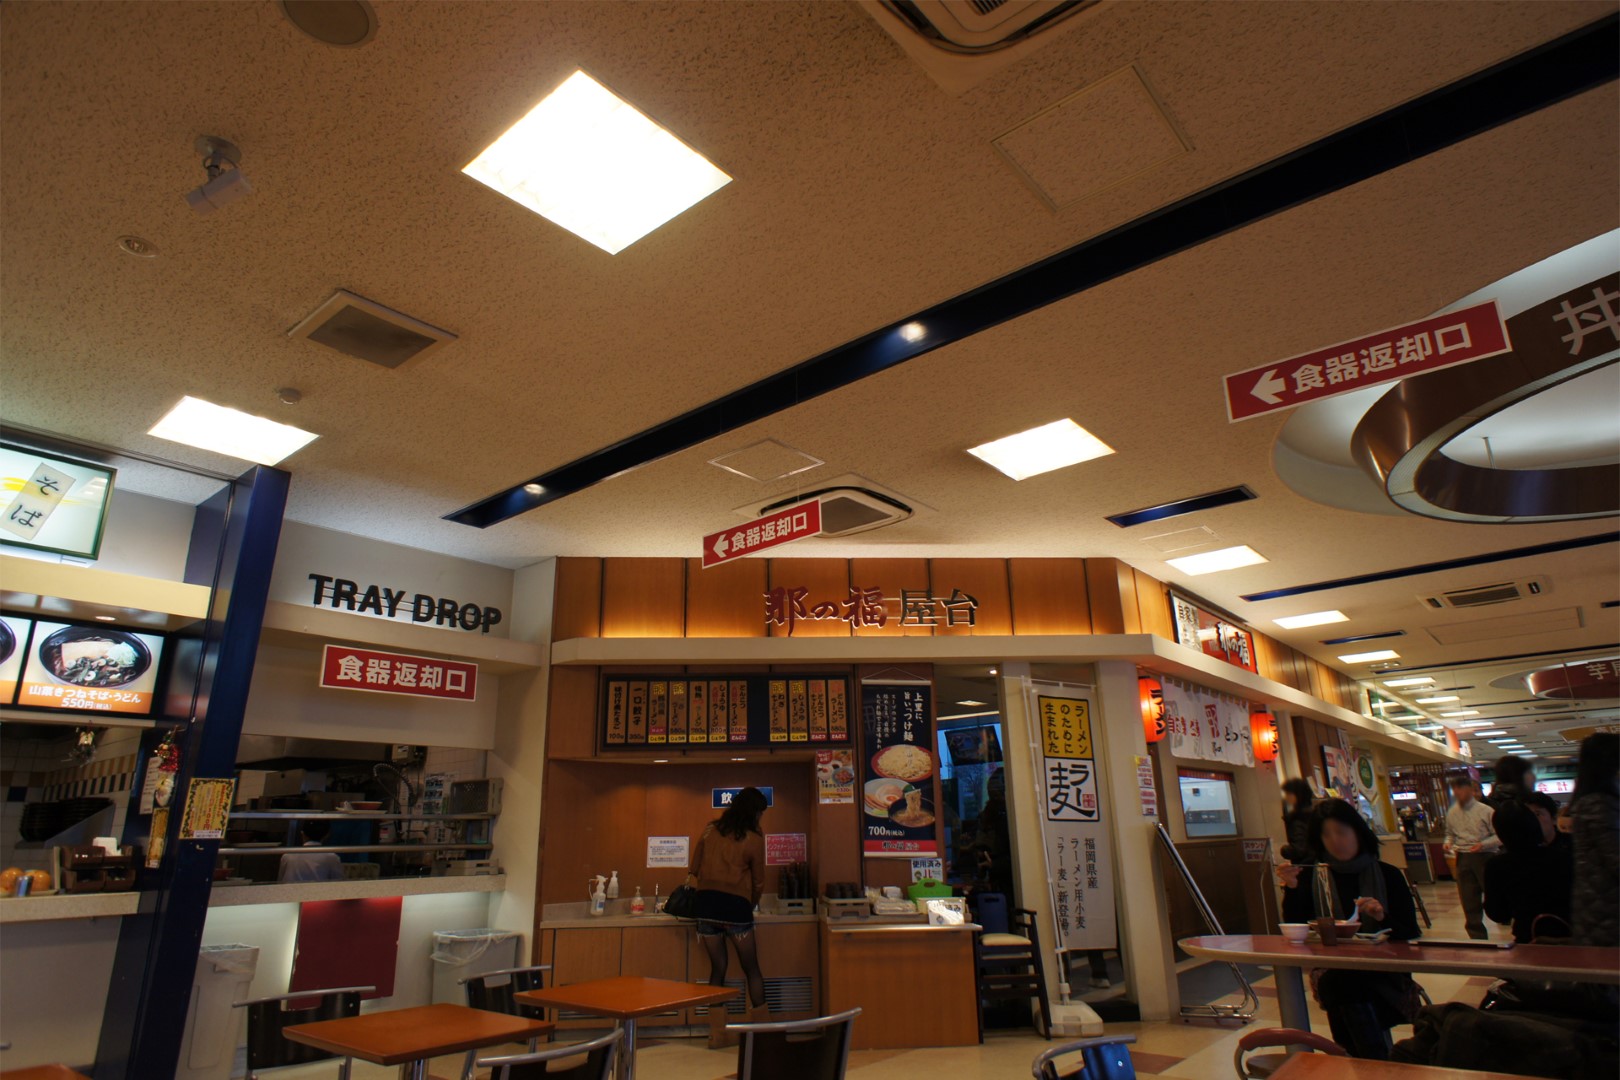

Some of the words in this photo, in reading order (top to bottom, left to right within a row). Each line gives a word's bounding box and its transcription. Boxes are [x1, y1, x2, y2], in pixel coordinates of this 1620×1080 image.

[1291, 322, 1473, 394] 食器返却口
[10, 476, 59, 528] そば
[731, 511, 808, 553] 食器返却口
[308, 573, 406, 617] TRAY
[412, 594, 502, 634] DROP
[762, 586, 889, 637] 那の福
[897, 588, 979, 628] 屋台
[29, 685, 141, 704] 山菜きつねそば・うどん
[336, 655, 467, 693] 食器返却口
[1045, 702, 1060, 754] 生まれた
[1060, 703, 1073, 754] のために
[1075, 705, 1088, 755] ラーメン
[912, 859, 941, 868] 使用済み
[1070, 838, 1086, 929] ラーメン用小麦
[1084, 837, 1098, 889] 福岡県産
